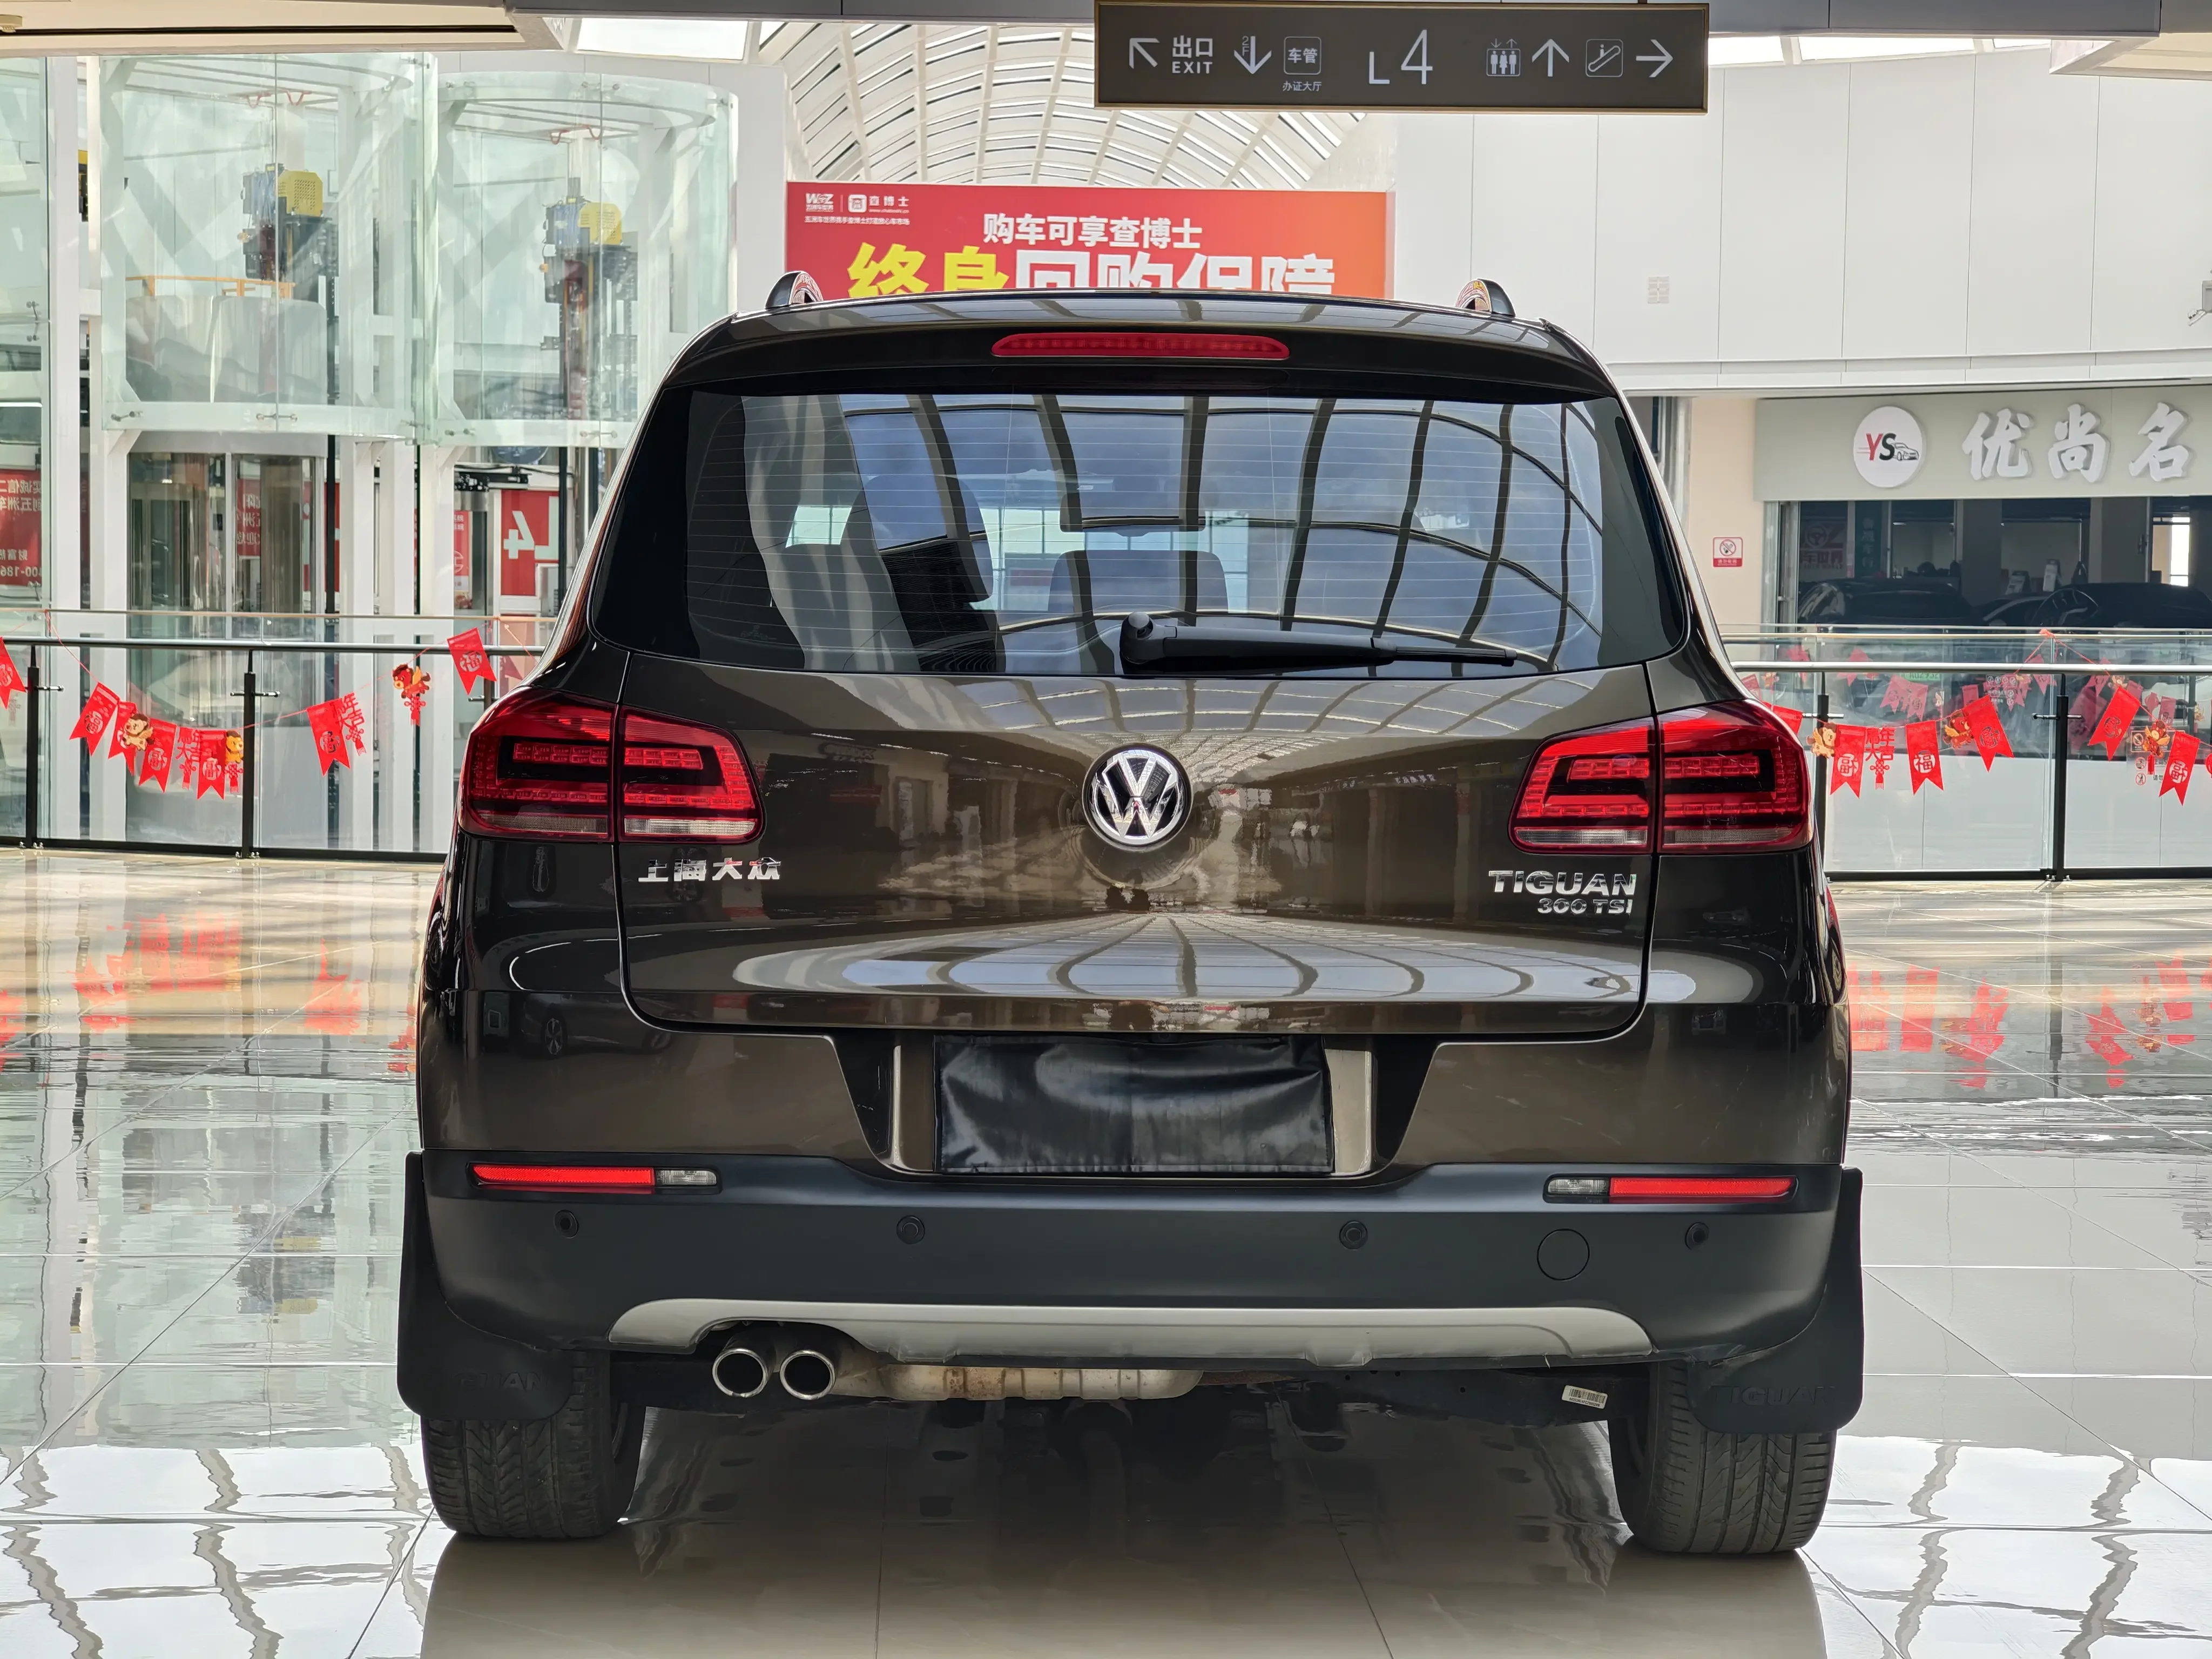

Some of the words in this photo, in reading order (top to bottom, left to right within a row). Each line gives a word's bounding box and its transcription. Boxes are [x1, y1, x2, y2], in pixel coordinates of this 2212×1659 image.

[1172, 35, 1213, 58] 出口
[1287, 48, 1318, 64] 车管
[1171, 61, 1213, 74] EXIT
[1282, 81, 1323, 92] 办证大厅
[868, 195, 911, 207] 查博士
[983, 213, 1204, 249] 购车可享查博士
[847, 242, 1336, 296] 终身回购保障
[1865, 432, 1897, 461] YS
[1962, 402, 2191, 483] 优尚名
[1913, 750, 1936, 774] 福
[638, 857, 782, 882] 上海大众
[1488, 870, 1637, 897] TIGUAN
[1537, 898, 1588, 915] 300
[1593, 899, 1634, 914] TSI
